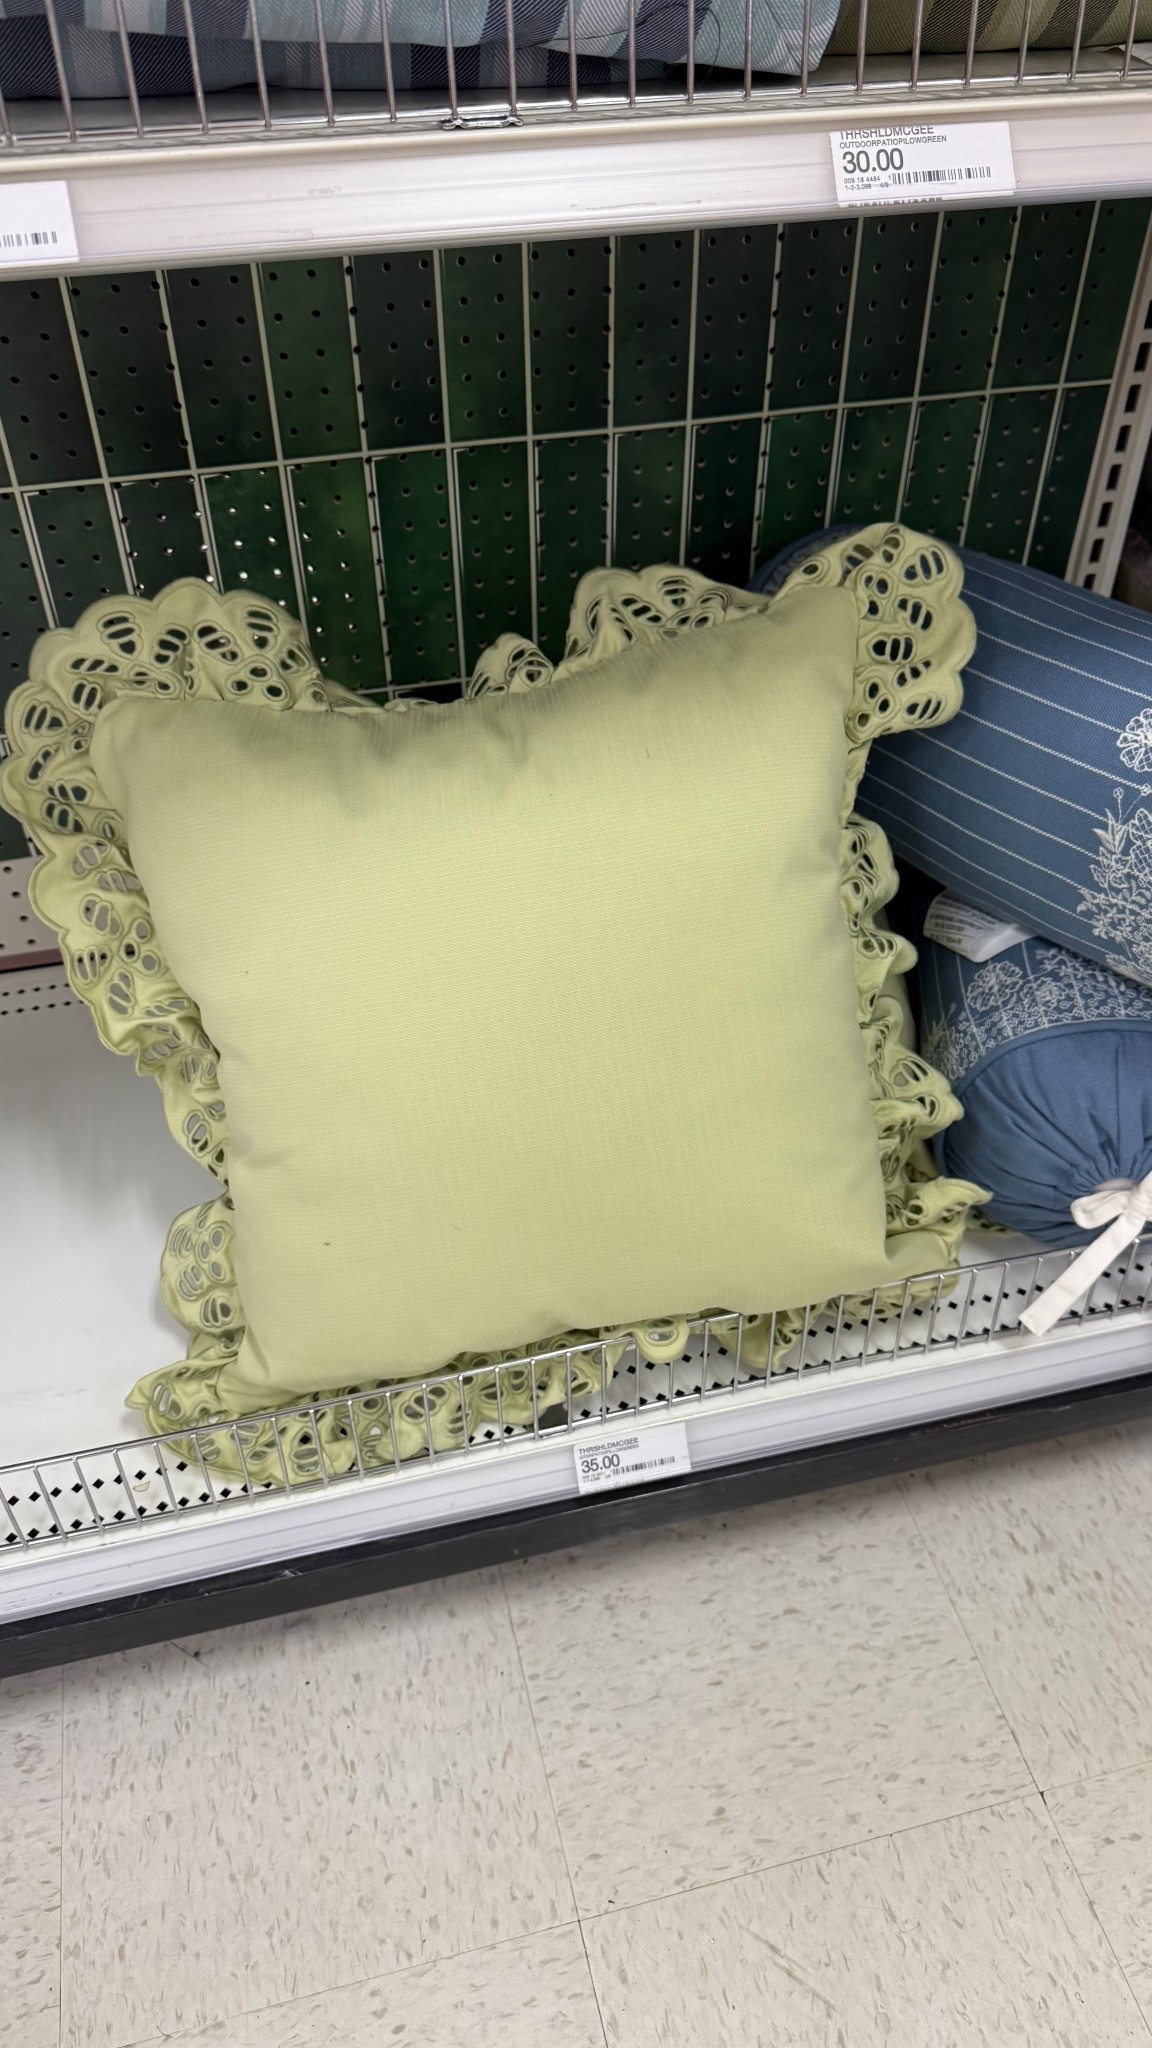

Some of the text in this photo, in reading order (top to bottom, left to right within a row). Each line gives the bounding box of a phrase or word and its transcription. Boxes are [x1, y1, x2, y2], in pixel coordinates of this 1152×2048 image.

[842, 148, 904, 173] 30.00
[578, 1437, 639, 1455] THRSHLDMCGEE
[581, 1453, 620, 1474] 35.00
